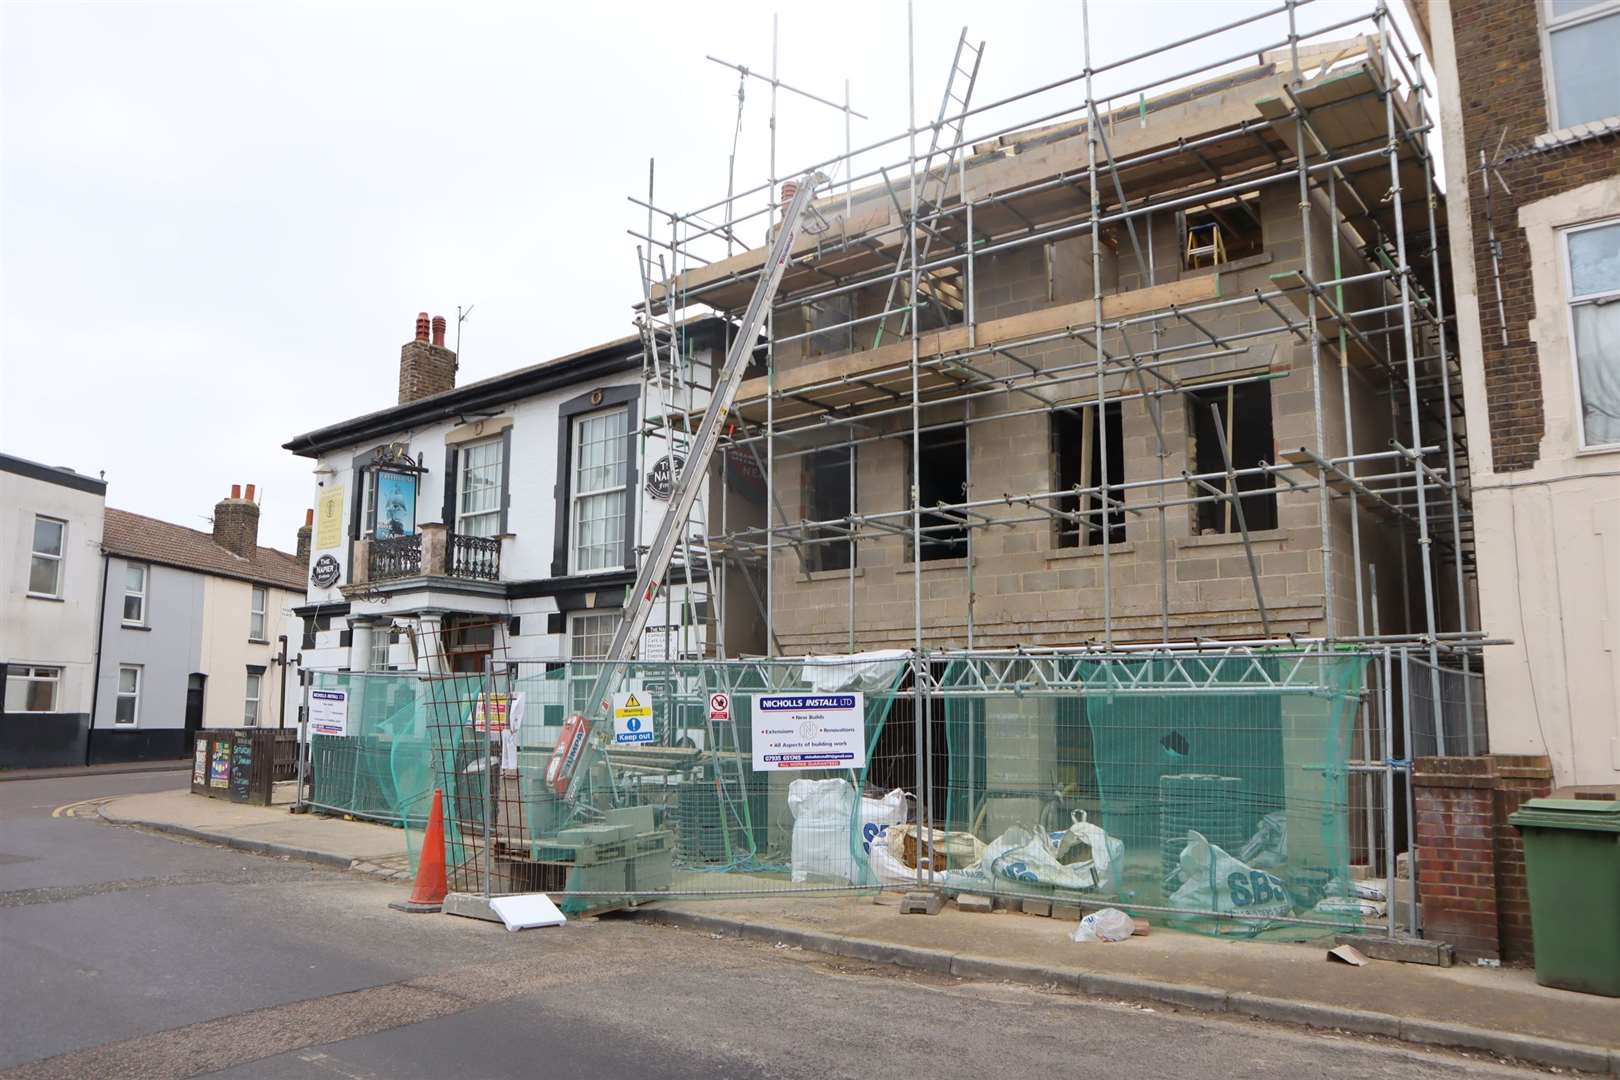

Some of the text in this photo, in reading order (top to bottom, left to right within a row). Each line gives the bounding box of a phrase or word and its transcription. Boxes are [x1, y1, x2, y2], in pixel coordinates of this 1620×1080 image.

[762, 698, 853, 708] NICHOLLS INSTALL LTD
[619, 734, 637, 742] Keep
